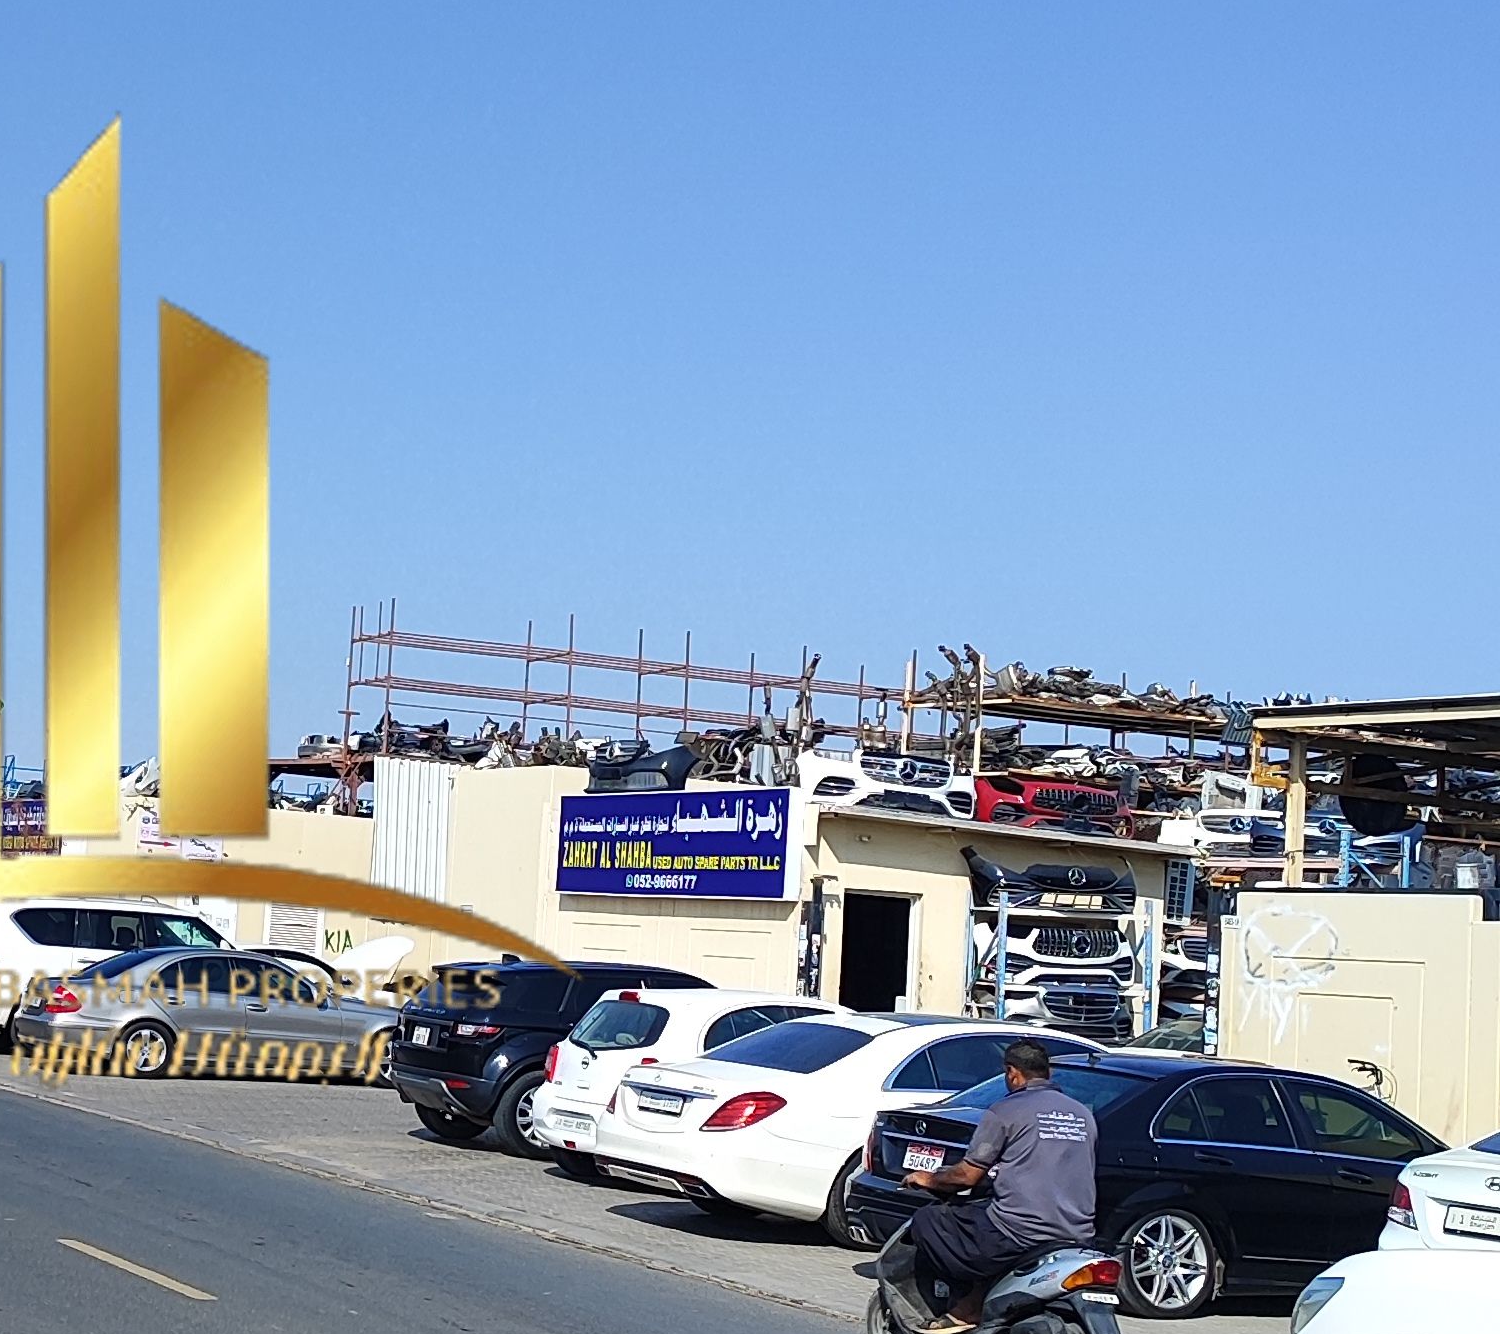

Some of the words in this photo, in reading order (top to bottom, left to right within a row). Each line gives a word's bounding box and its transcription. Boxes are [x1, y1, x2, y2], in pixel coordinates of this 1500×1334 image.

[563, 840, 598, 868] ZAHRAT
[600, 841, 611, 869] AL
[615, 840, 652, 869] SHAHBA
[653, 856, 672, 870] USED
[673, 856, 694, 870] AUTO
[720, 856, 746, 870] PARTS
[325, 929, 353, 954] KIA
